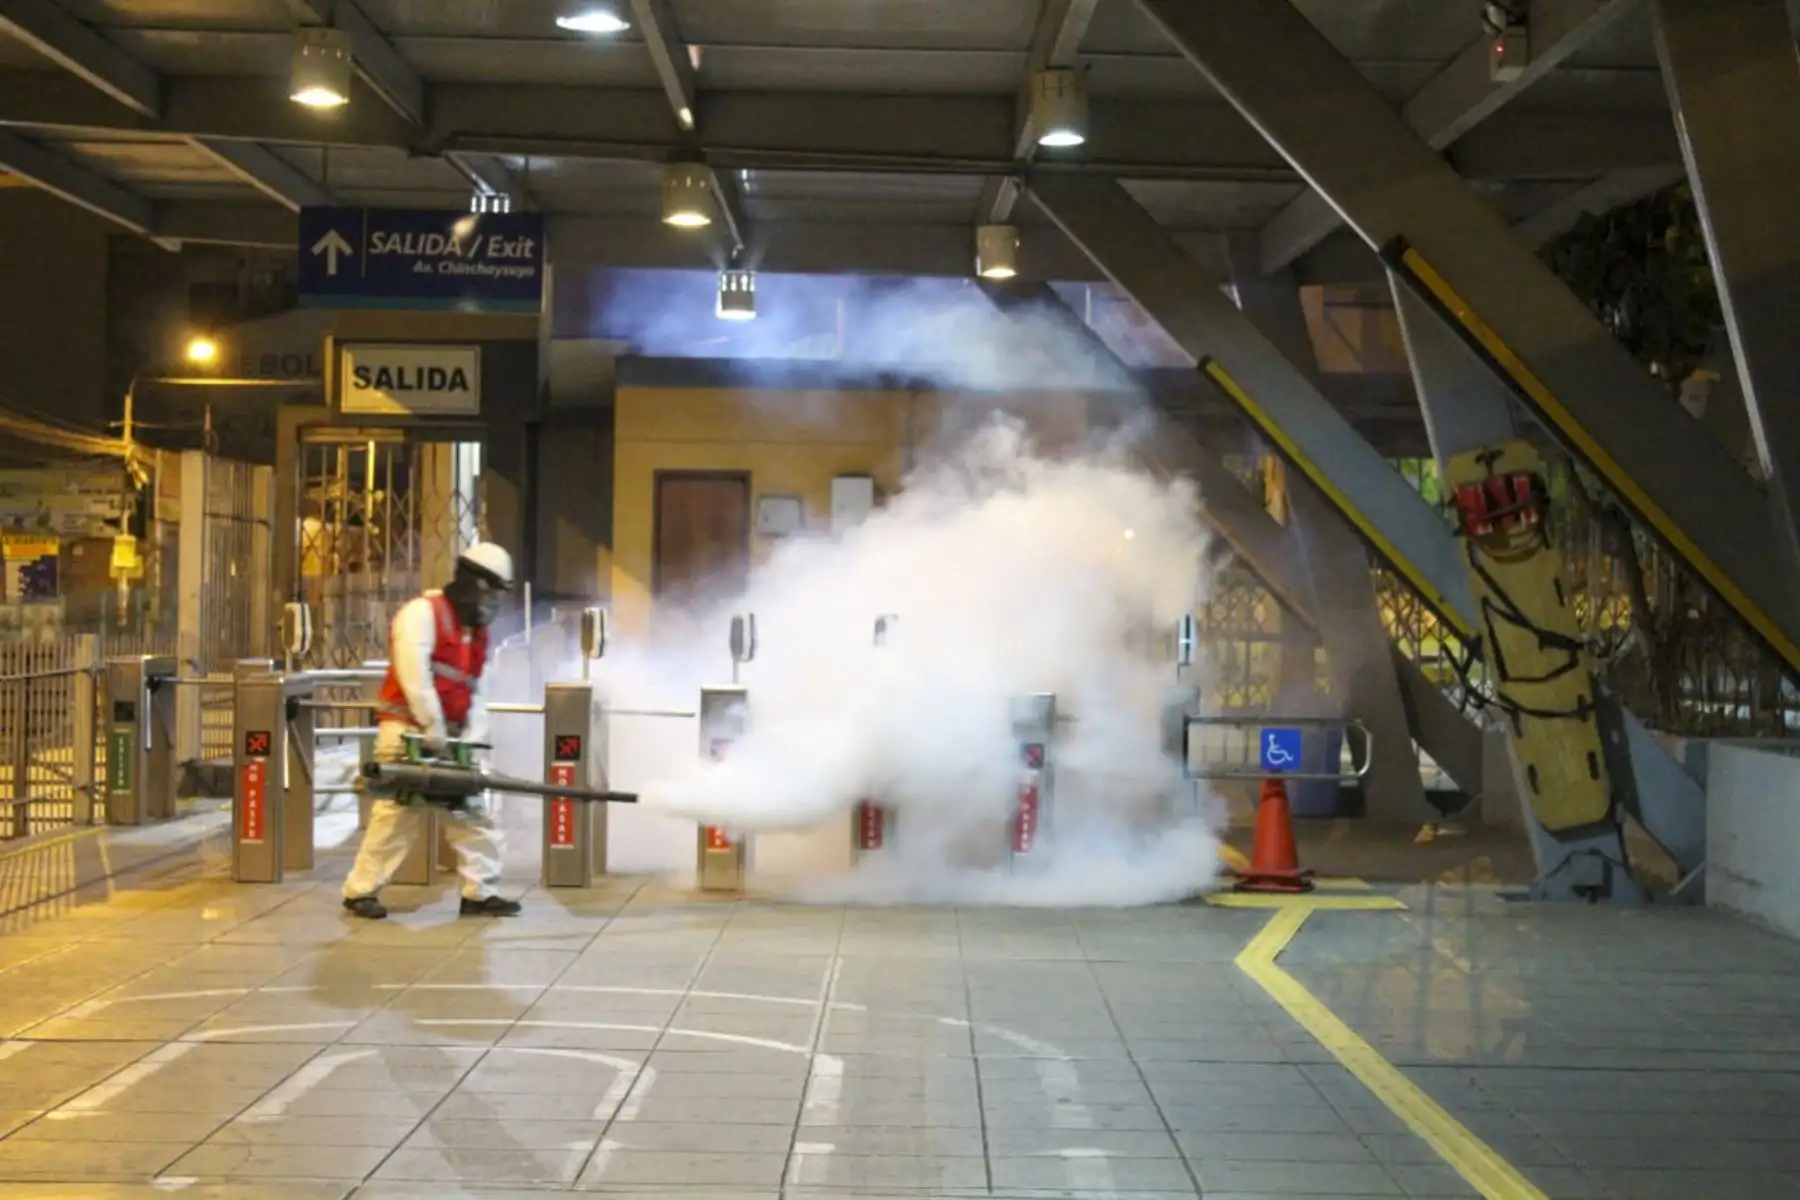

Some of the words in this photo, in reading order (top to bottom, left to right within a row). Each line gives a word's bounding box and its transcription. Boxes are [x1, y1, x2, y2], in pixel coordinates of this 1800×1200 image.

[371, 231, 462, 257] SALIDA
[487, 236, 534, 258] Exit
[353, 366, 469, 392] SALIDA
